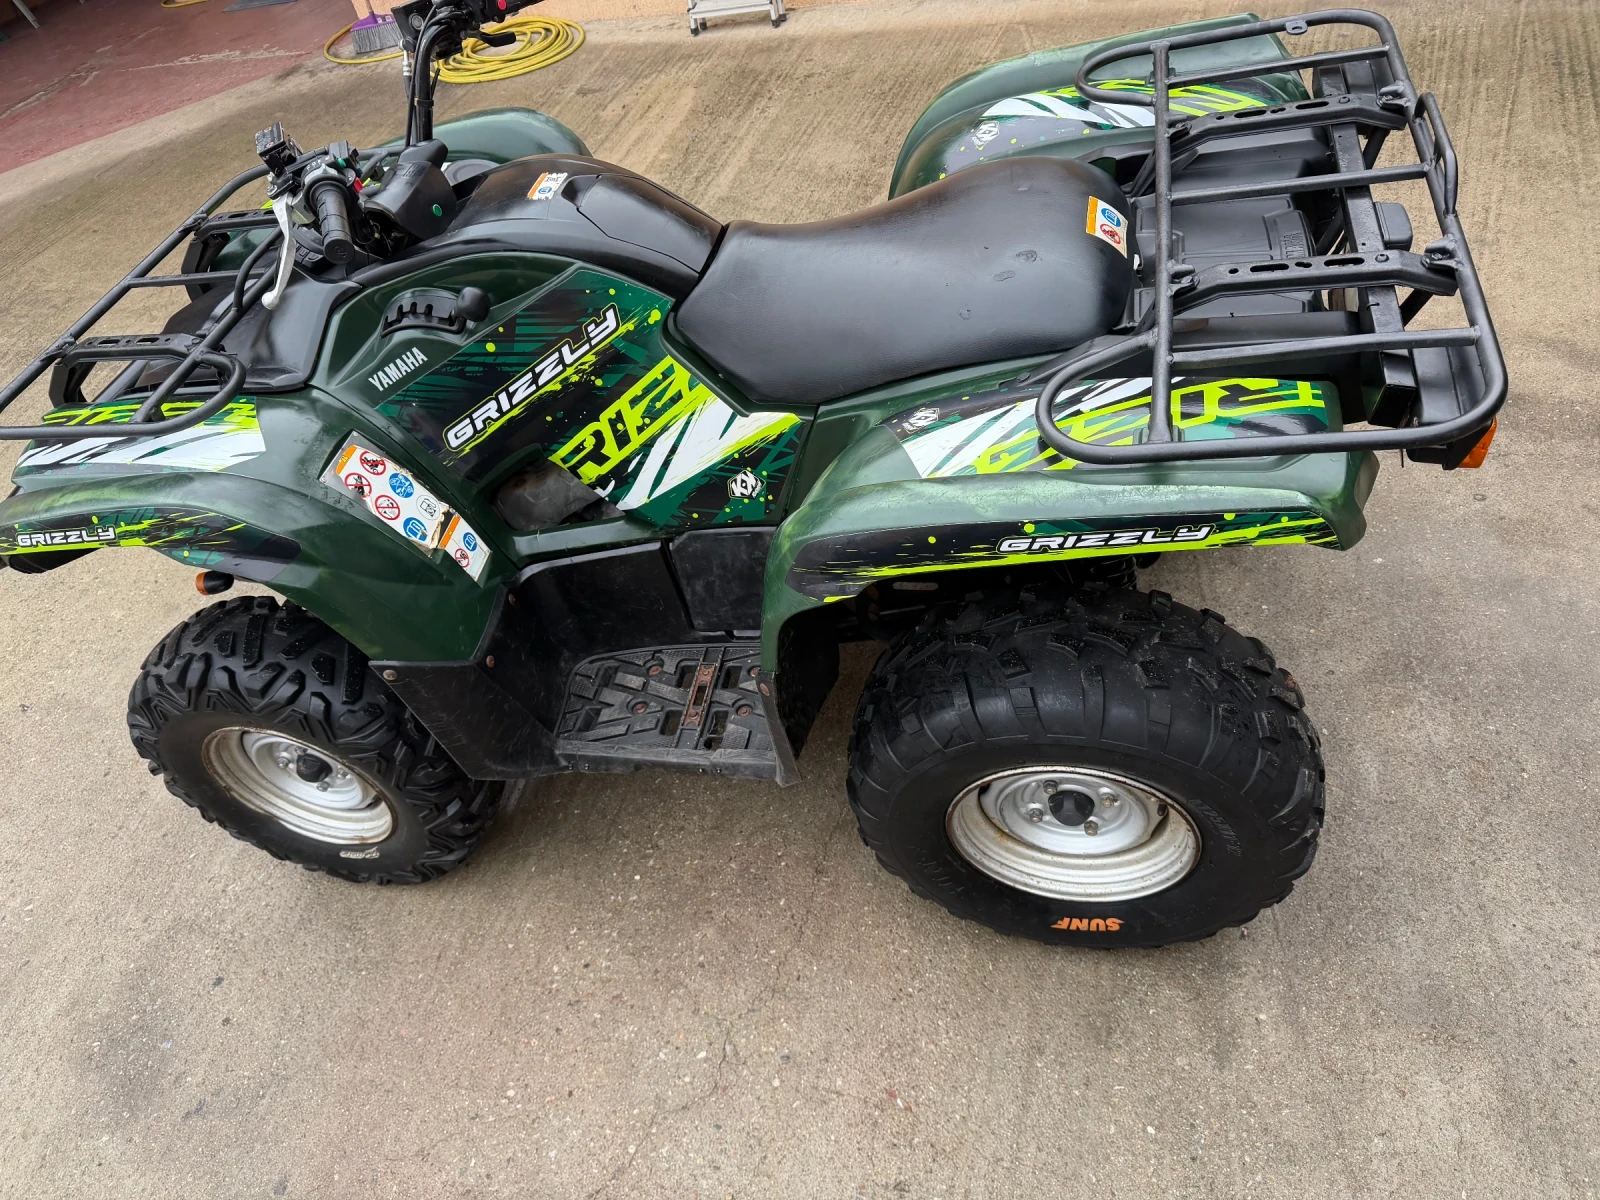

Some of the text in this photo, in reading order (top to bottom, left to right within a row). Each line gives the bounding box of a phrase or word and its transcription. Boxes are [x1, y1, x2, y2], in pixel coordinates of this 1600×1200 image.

[367, 346, 428, 392] YAMAHA
[446, 306, 618, 449] GRIZZLY
[16, 526, 116, 547] GRIZZLY
[999, 525, 1212, 552] GRIZZLY
[1049, 917, 1126, 932] SUNF
